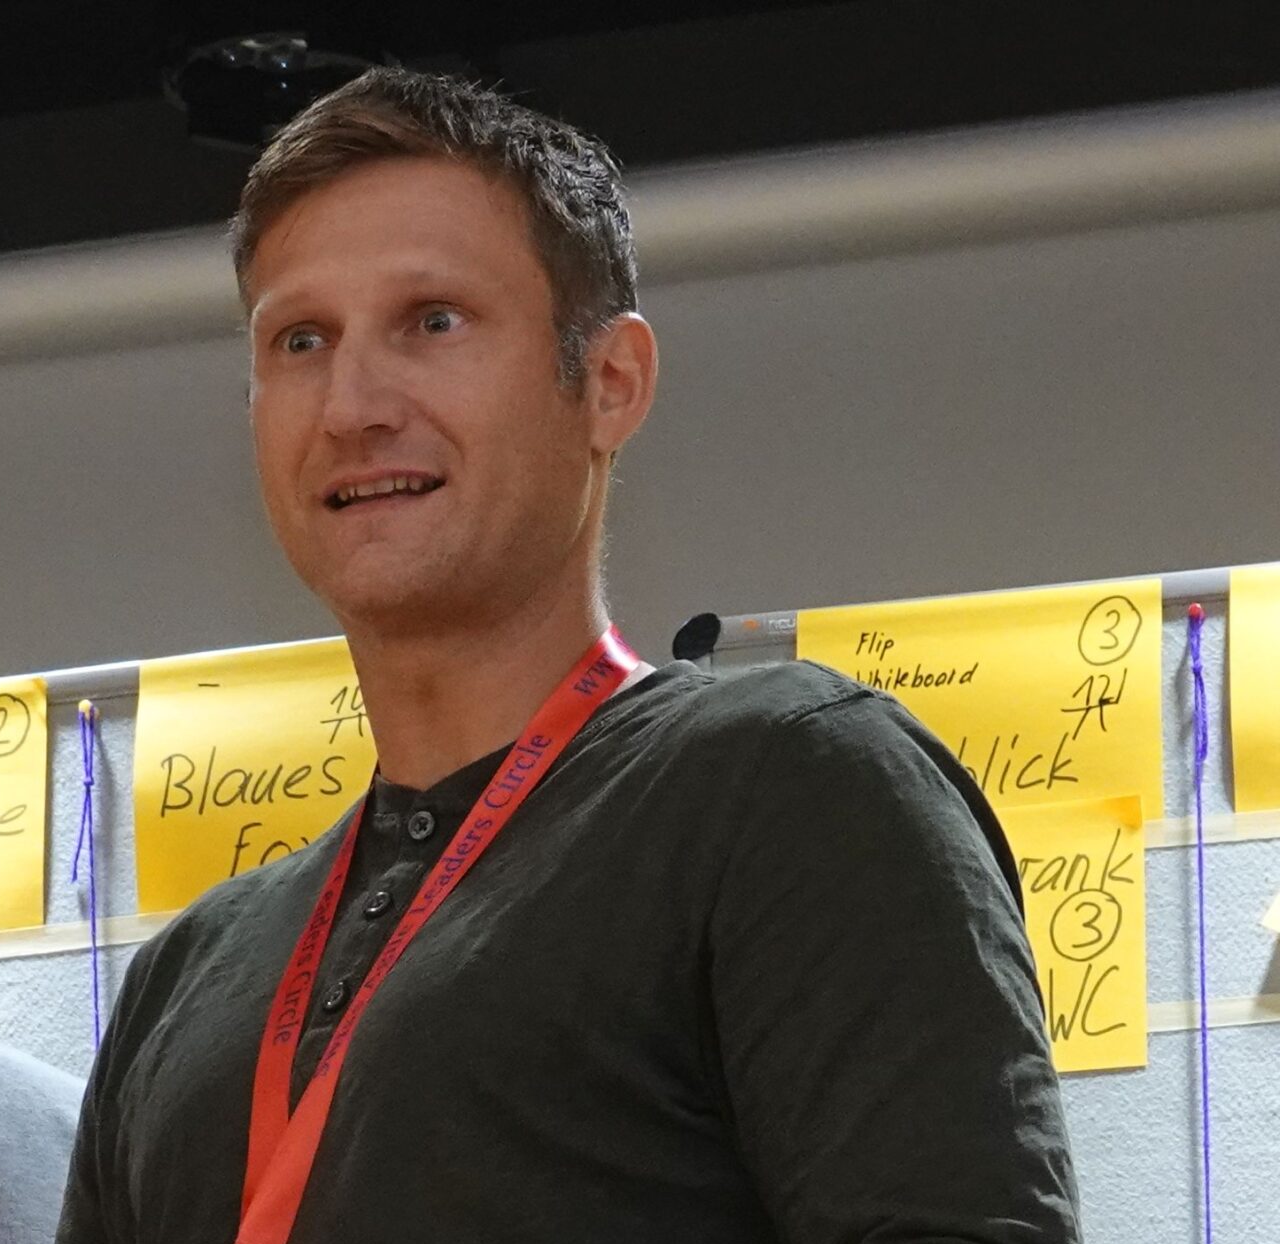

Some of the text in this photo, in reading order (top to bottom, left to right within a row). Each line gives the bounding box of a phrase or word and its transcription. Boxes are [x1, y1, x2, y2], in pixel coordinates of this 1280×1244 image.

[856, 631, 895, 661] Flip
[159, 746, 347, 819] Blaues
[483, 734, 553, 810] Circle
[272, 970, 313, 1046] Circle
[1048, 963, 1128, 1043] WC
